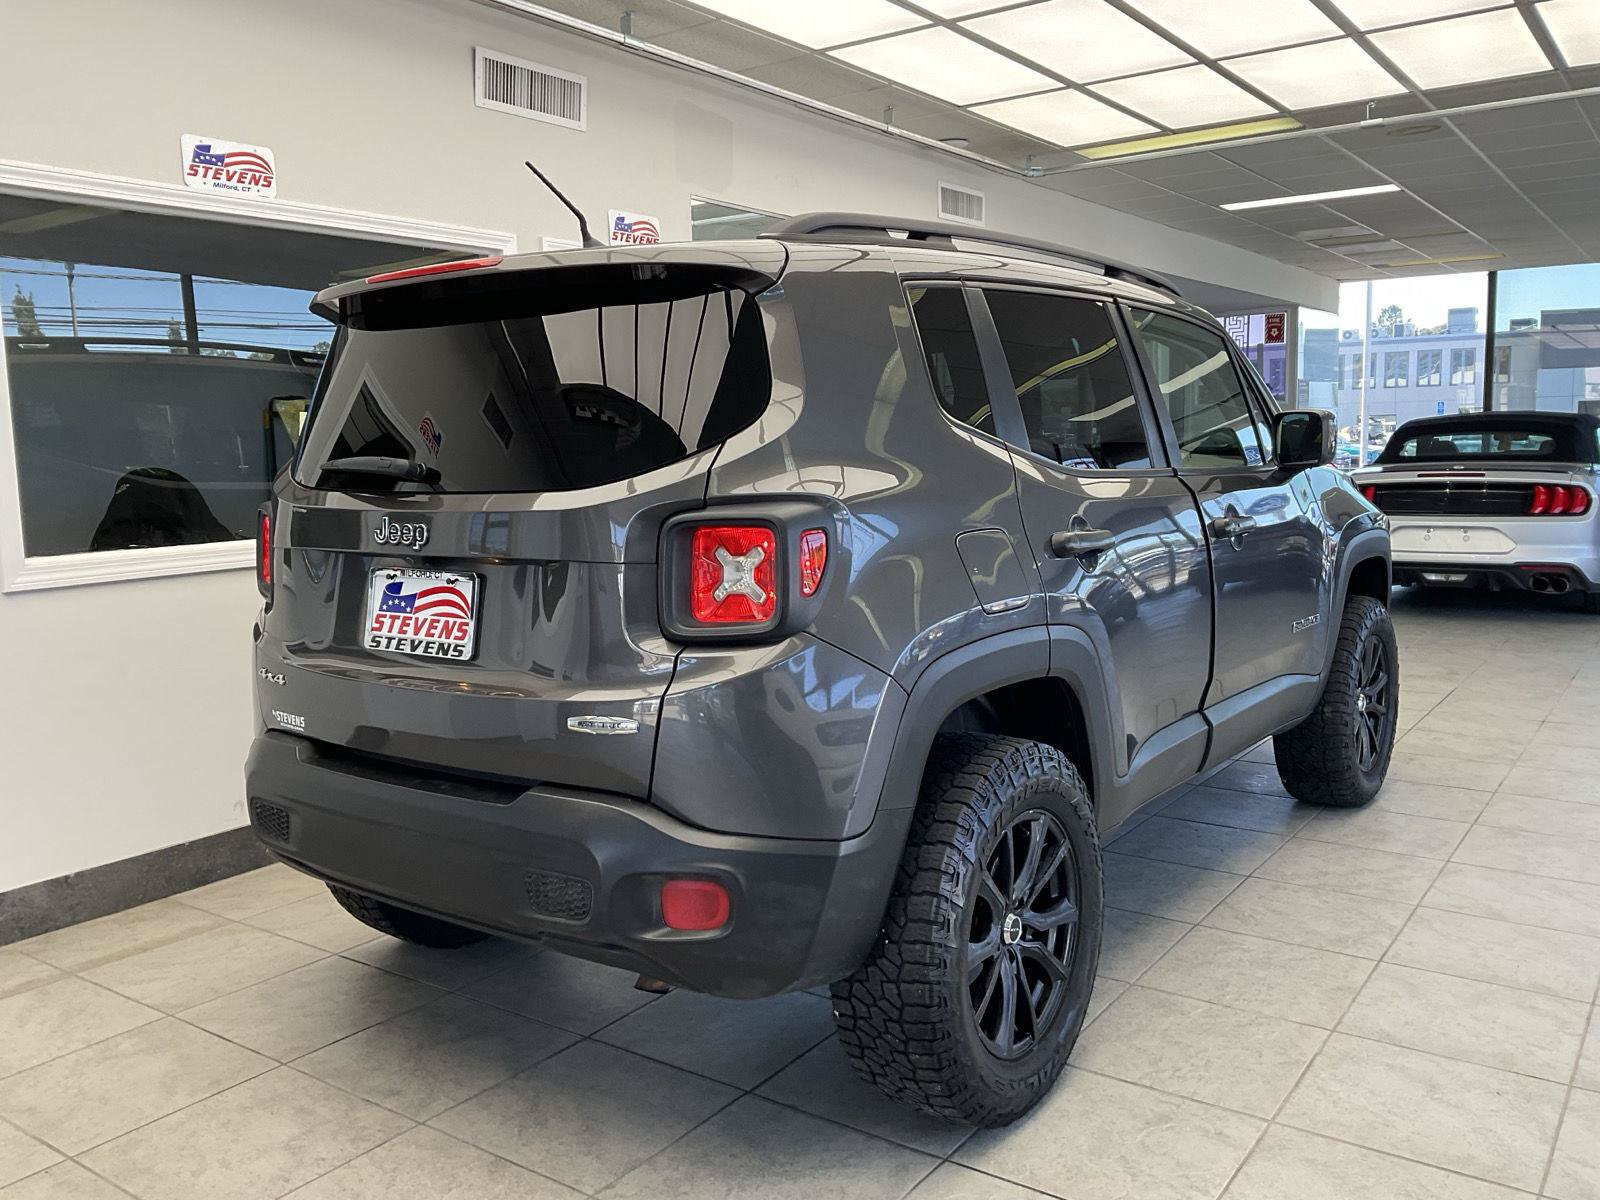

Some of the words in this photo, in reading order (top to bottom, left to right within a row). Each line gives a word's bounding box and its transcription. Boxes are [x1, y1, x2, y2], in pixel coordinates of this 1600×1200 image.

[187, 163, 274, 188] STEVENS
[212, 182, 240, 192] Milford,
[374, 516, 429, 550] Jeep
[371, 613, 470, 642] STEVENS
[368, 635, 466, 658] STEVENS
[258, 667, 288, 686] 4x4
[275, 710, 305, 728] STEVENS
